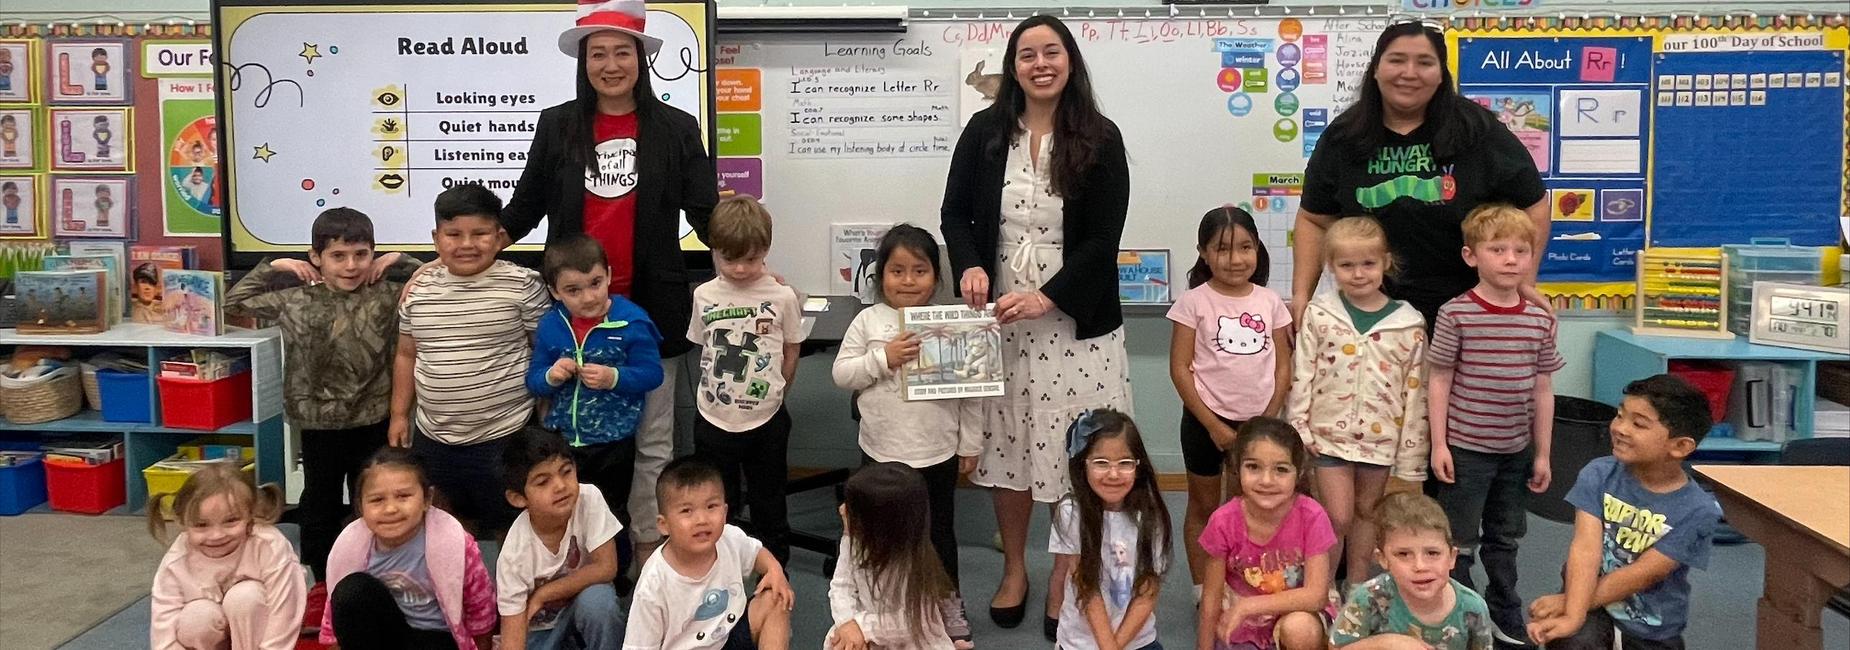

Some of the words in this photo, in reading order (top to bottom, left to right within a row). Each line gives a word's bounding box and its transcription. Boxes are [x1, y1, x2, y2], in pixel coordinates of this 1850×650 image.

[398, 37, 455, 55] Read
[461, 37, 529, 55] Aloud
[824, 42, 886, 60] Learning
[893, 38, 933, 57] Goals
[1664, 40, 1688, 51] our
[1693, 36, 1727, 49] 100th
[1732, 36, 1758, 49] Day
[1762, 35, 1775, 47] of
[1778, 35, 1824, 47] School
[158, 49, 193, 66] Our
[1235, 56, 1261, 64] winter
[1481, 51, 1509, 69] All
[1515, 50, 1572, 69] About
[1587, 51, 1611, 71] Rr
[59, 52, 84, 96] L
[171, 84, 194, 93] How
[790, 81, 800, 94] I
[828, 83, 876, 96] recognize
[883, 80, 917, 93] Letter
[924, 79, 940, 92] Rr
[437, 92, 496, 107] Looking
[501, 95, 536, 107] eyes
[1578, 97, 1599, 123] R
[790, 112, 800, 124] I
[802, 117, 823, 125] can
[829, 115, 875, 125] recognize
[439, 120, 482, 135] Quiet
[489, 120, 535, 132] hands
[61, 120, 86, 163] L
[844, 142, 874, 154] listening
[877, 142, 894, 153] body
[909, 141, 928, 152] circle
[434, 148, 504, 163] Listening
[508, 151, 530, 161] ea
[590, 172, 635, 187] THINGS
[722, 171, 749, 179] yourself
[62, 188, 86, 231] L
[911, 311, 931, 320] WHERE
[932, 311, 943, 320] THE
[945, 311, 959, 319] WILD
